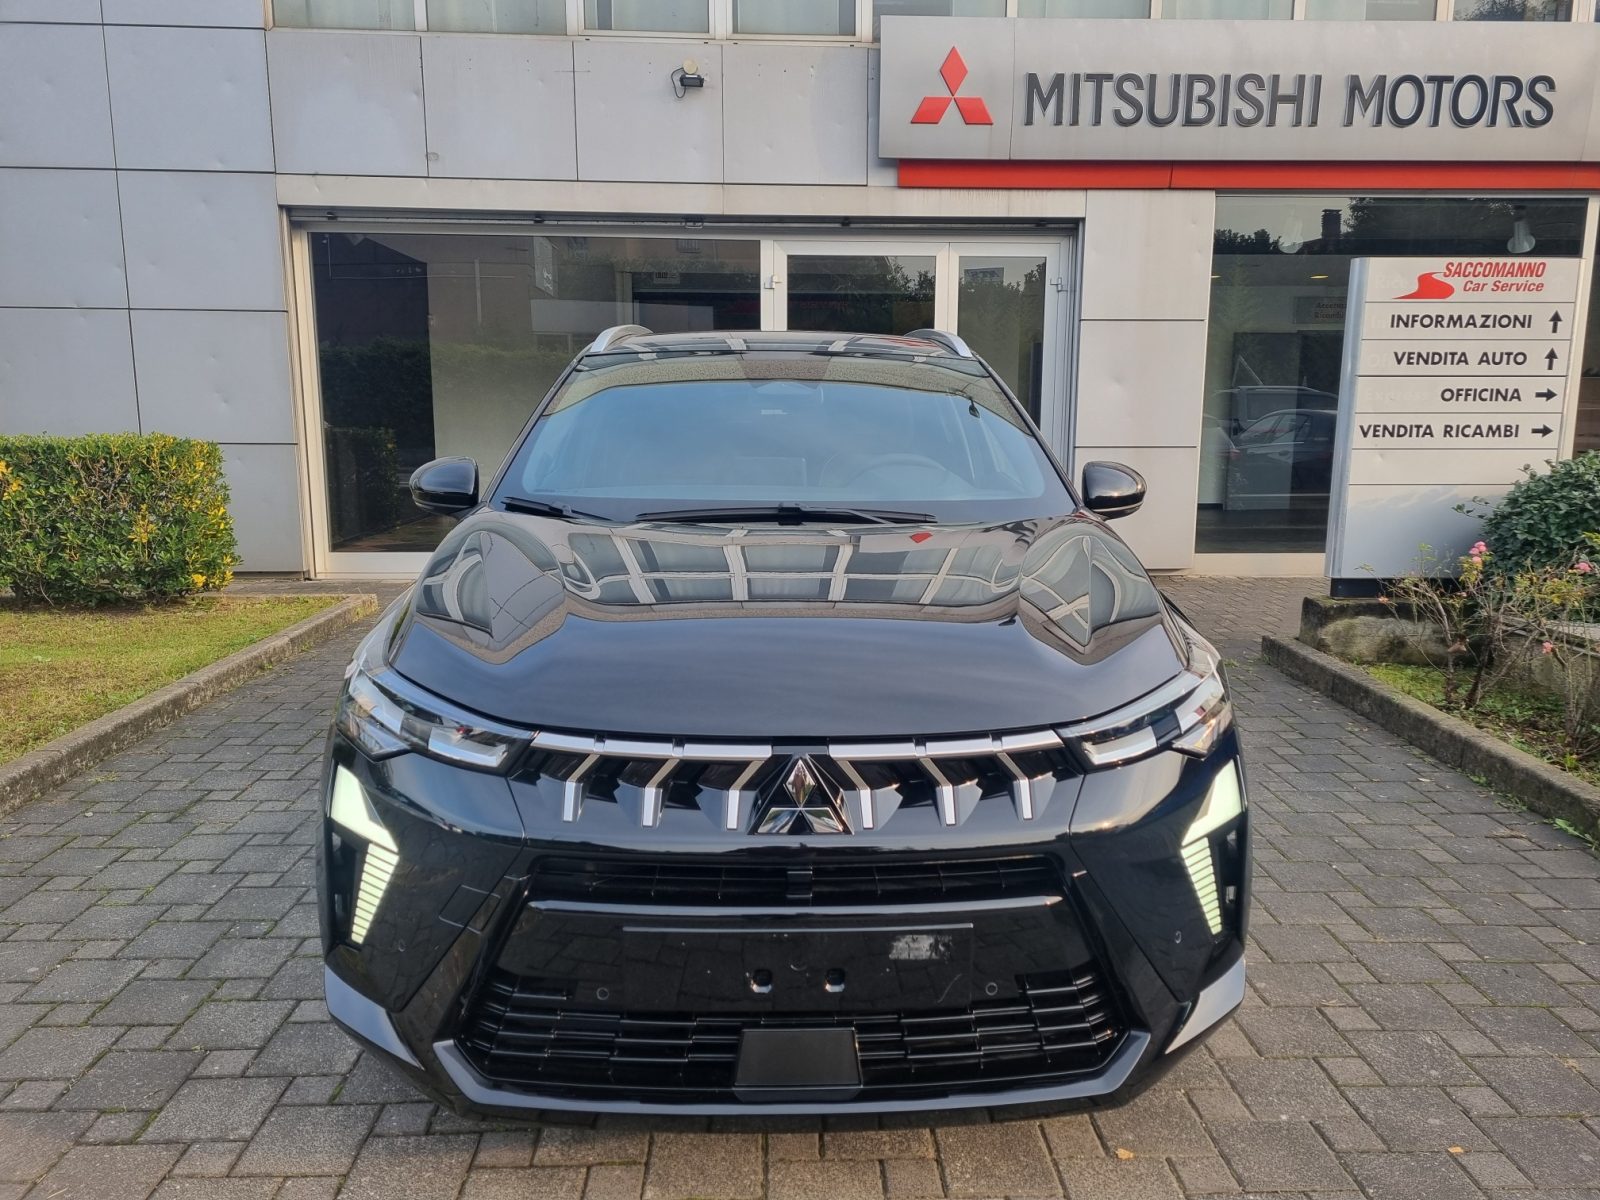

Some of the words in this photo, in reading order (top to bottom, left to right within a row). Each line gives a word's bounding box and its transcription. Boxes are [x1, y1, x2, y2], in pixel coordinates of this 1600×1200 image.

[1024, 72, 1322, 128] MITSUBISHI
[1344, 74, 1556, 129] MOTORS
[1443, 261, 1547, 278] SACCOMANNO
[1463, 280, 1488, 292] Car
[1491, 280, 1545, 292] Service
[1390, 314, 1533, 329] INFORMAZIONI
[1394, 351, 1469, 366] VENDITA
[1477, 351, 1528, 366] AUTO
[1440, 388, 1522, 402] OFFICINA
[1359, 424, 1435, 438] VENDITA
[1442, 424, 1520, 438] RICAMBI
